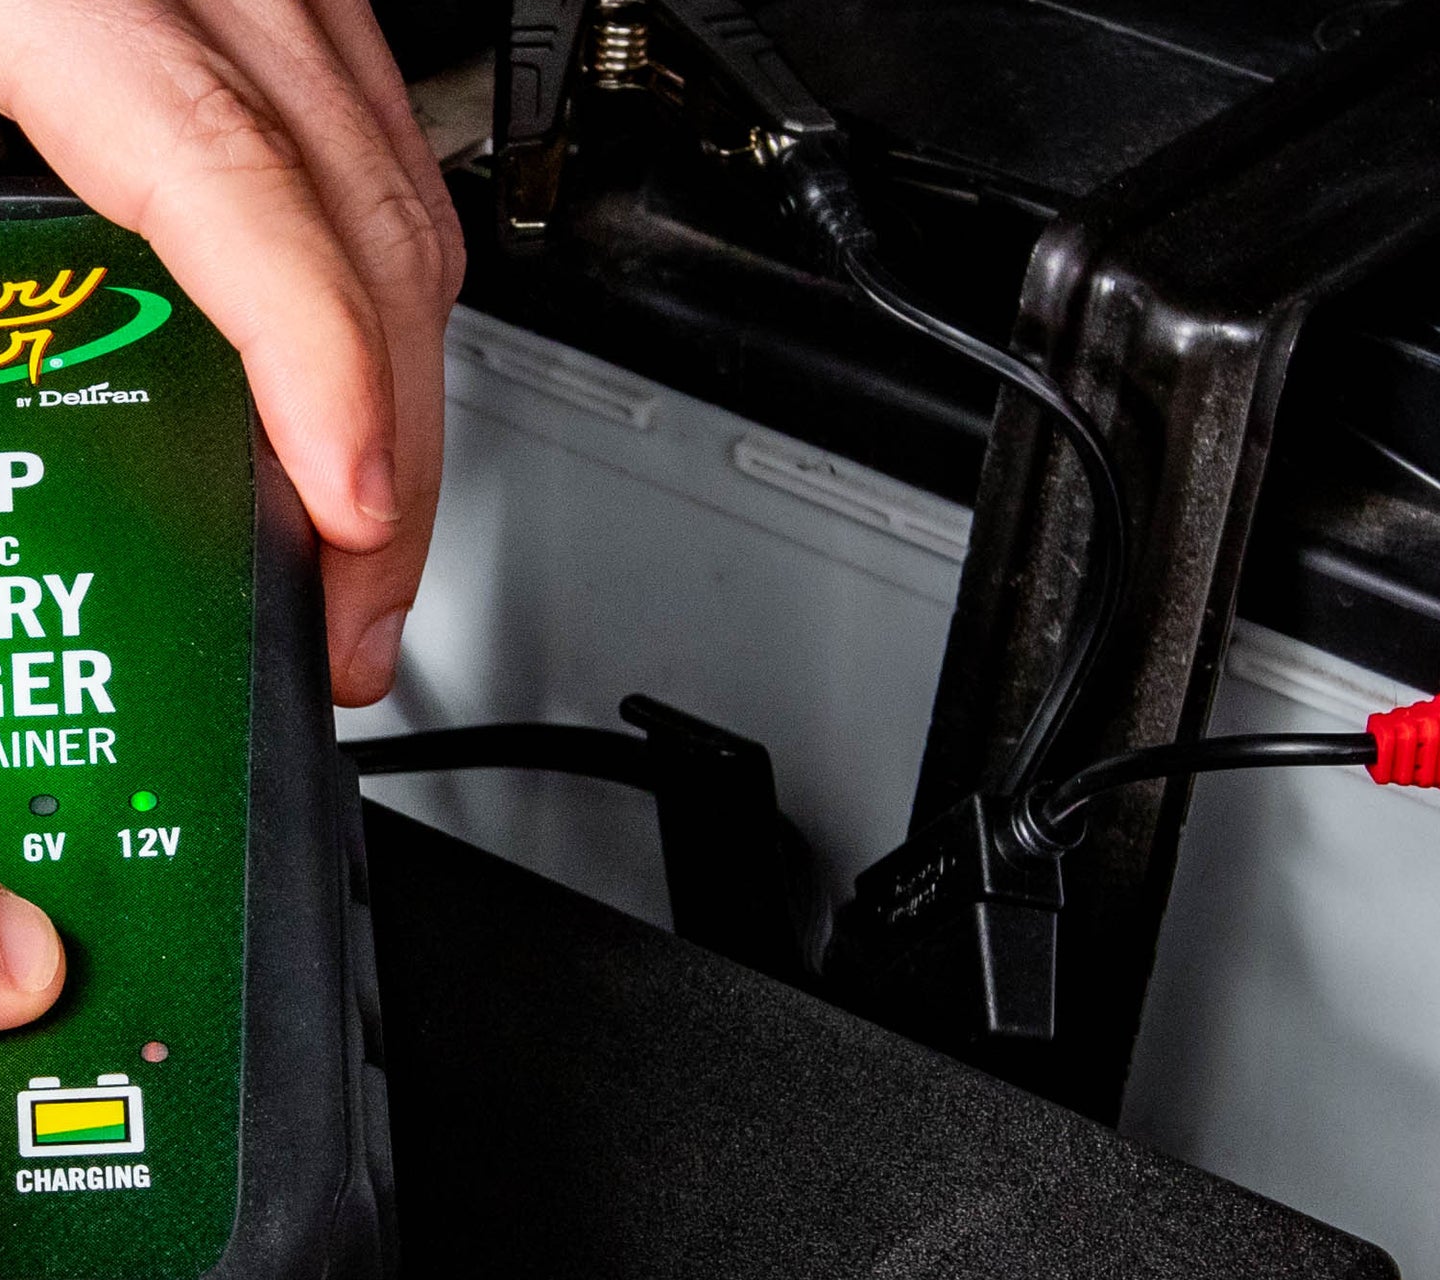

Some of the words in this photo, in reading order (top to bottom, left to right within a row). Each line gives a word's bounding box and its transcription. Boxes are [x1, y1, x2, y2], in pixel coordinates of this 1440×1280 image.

[16, 397, 32, 408] BY
[23, 832, 66, 862] 6V
[117, 826, 181, 861] 12V
[16, 1164, 151, 1193] CHARGING
